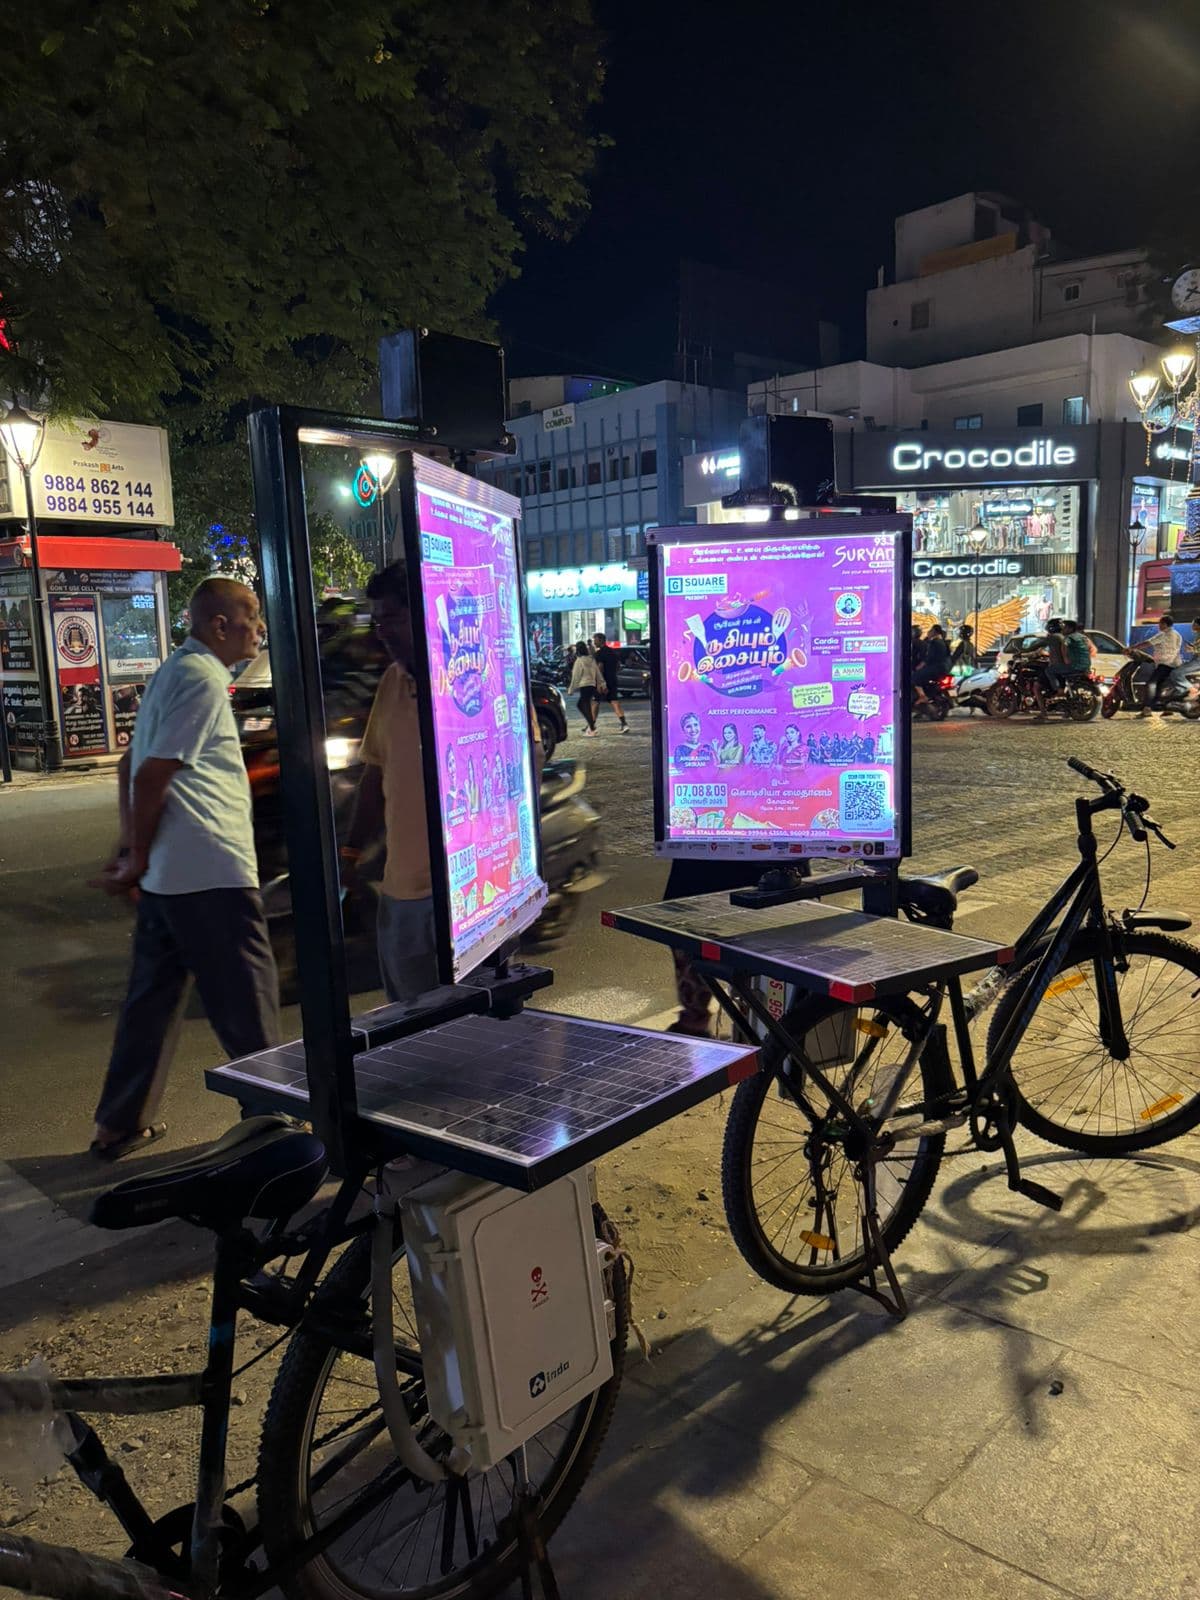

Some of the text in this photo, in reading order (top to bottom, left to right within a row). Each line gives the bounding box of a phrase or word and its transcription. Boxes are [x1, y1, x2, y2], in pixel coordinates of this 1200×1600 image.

[545, 416, 573, 429] COMPLEX
[892, 439, 1076, 471] Crocodile
[73, 460, 99, 469] Prakash
[44, 474, 153, 498] 9884 862 144
[46, 495, 155, 517] 9884 955 144
[431, 537, 452, 554] SQUARE
[913, 558, 1023, 577] Crocodile
[684, 576, 725, 587] SQUARE
[697, 645, 785, 674] இசையும்
[729, 707, 777, 715] PERFORMANCE
[730, 787, 833, 799] கொடிசியா மைதானம்
[546, 1360, 570, 1383] indo
